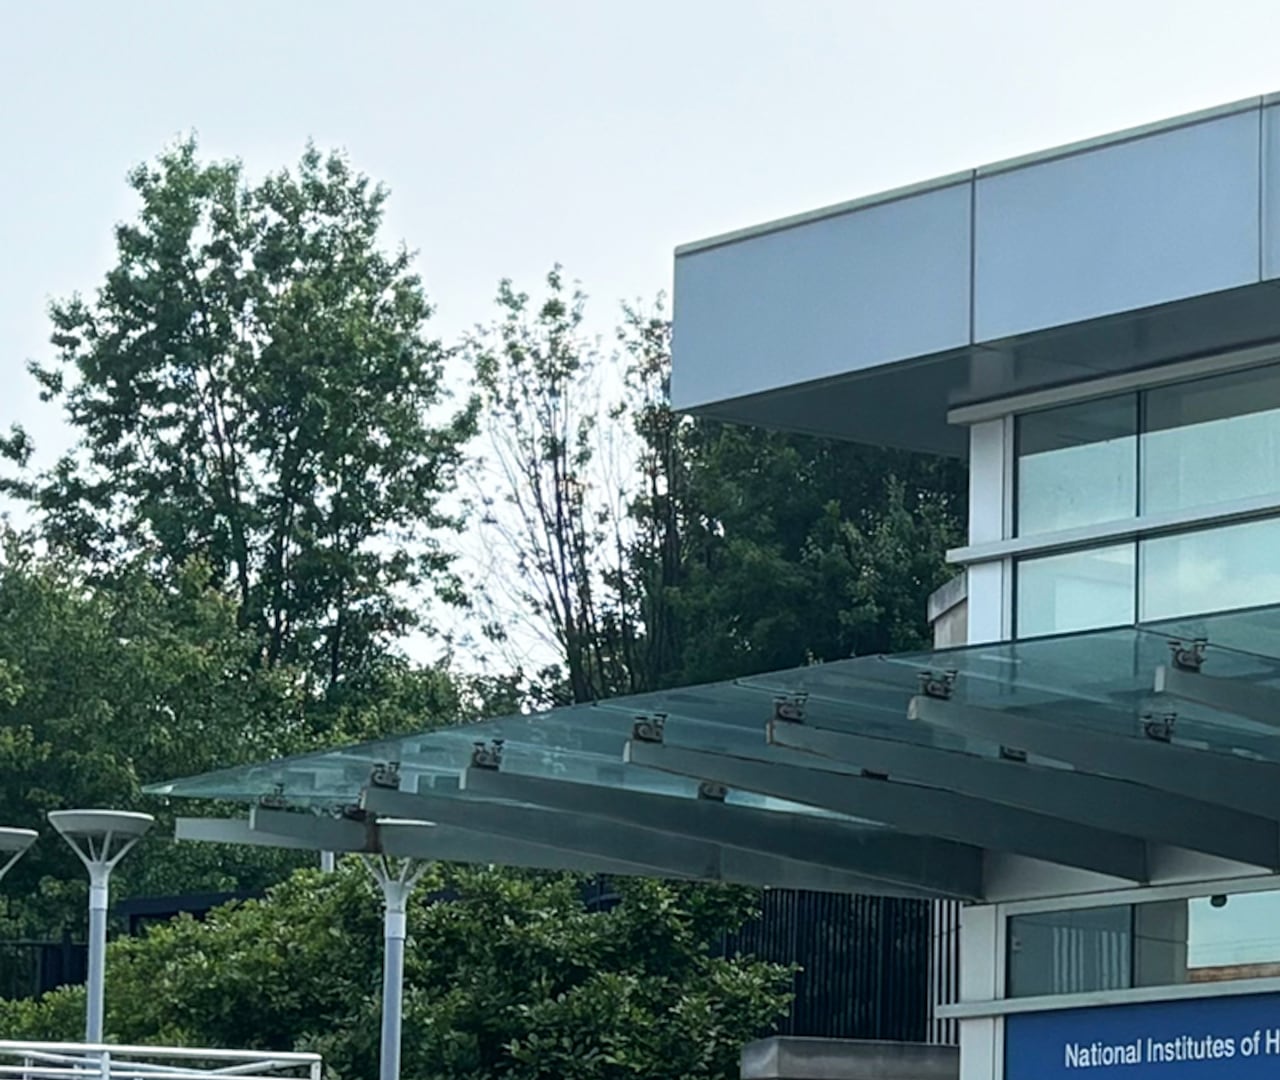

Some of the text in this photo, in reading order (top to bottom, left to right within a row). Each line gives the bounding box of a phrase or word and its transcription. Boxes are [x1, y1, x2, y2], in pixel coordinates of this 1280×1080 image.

[1066, 1039, 1141, 1067] National
[1148, 1036, 1235, 1062] Institutes
[1241, 1030, 1260, 1056] of
